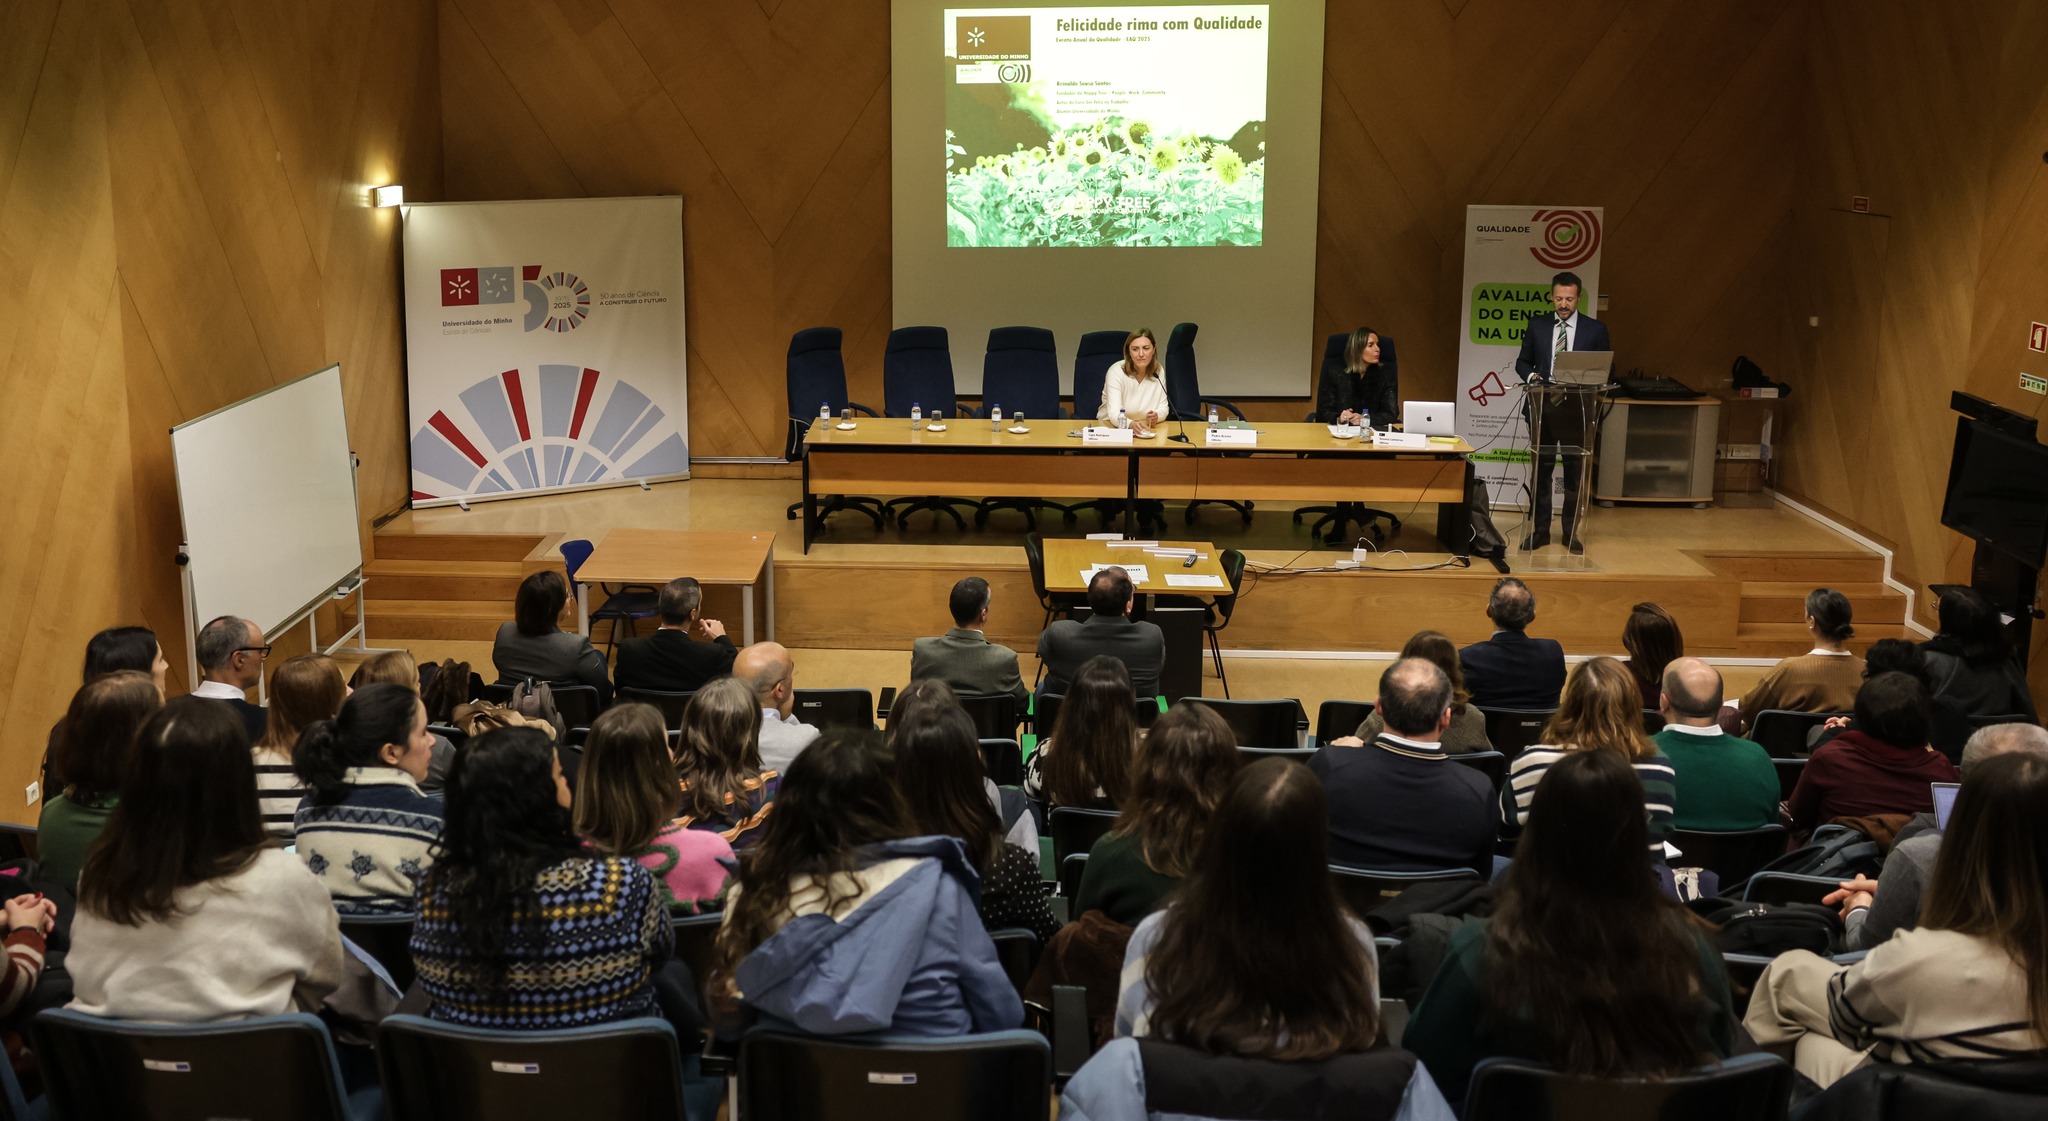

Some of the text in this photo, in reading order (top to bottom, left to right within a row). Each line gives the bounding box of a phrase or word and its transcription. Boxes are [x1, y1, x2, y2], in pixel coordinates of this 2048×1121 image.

[1056, 15, 1263, 32] Felicidade rima com Qualidade
[1115, 196, 1151, 209] TREE
[1476, 225, 1531, 234] QUALIDADE
[600, 292, 609, 300] 50
[637, 290, 660, 298] Ciência
[1478, 289, 1553, 305] AVALIAÇ
[1478, 308, 1504, 320] DO
[442, 319, 483, 327] Universidade
[442, 328, 461, 336] Escola
[1478, 327, 1502, 340] NA
[1485, 454, 1515, 462] contributo
